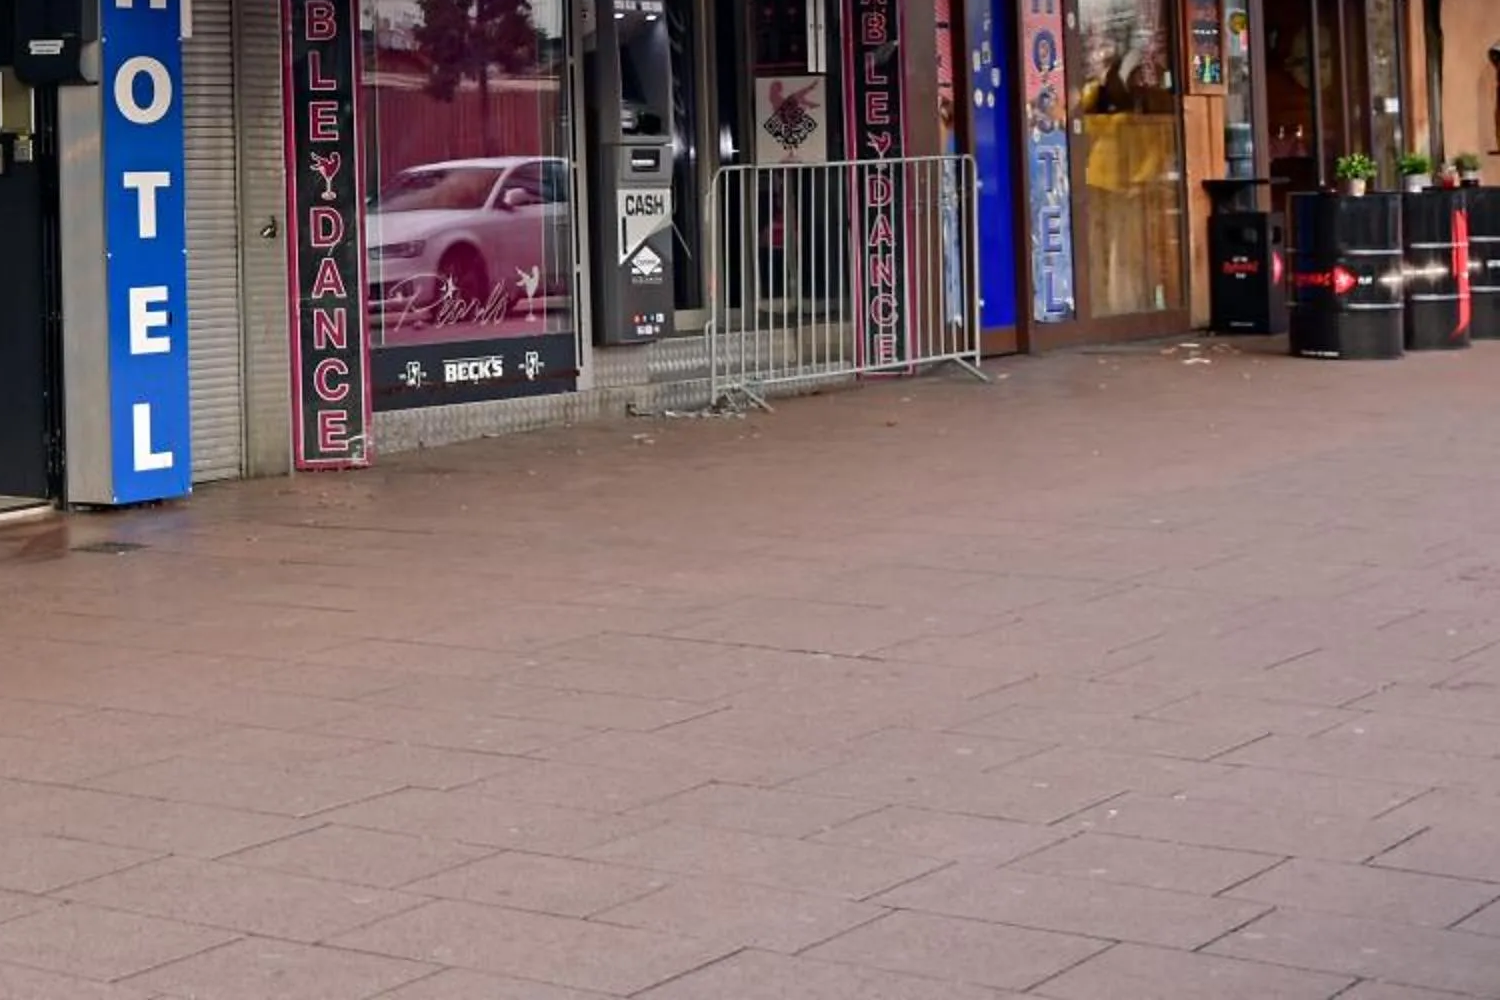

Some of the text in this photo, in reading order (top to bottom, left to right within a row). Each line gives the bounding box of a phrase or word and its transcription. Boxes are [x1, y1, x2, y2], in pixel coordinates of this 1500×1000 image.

[626, 195, 665, 217] CASH
[310, 204, 349, 453] DANCE
[444, 356, 503, 384] BECK'S
